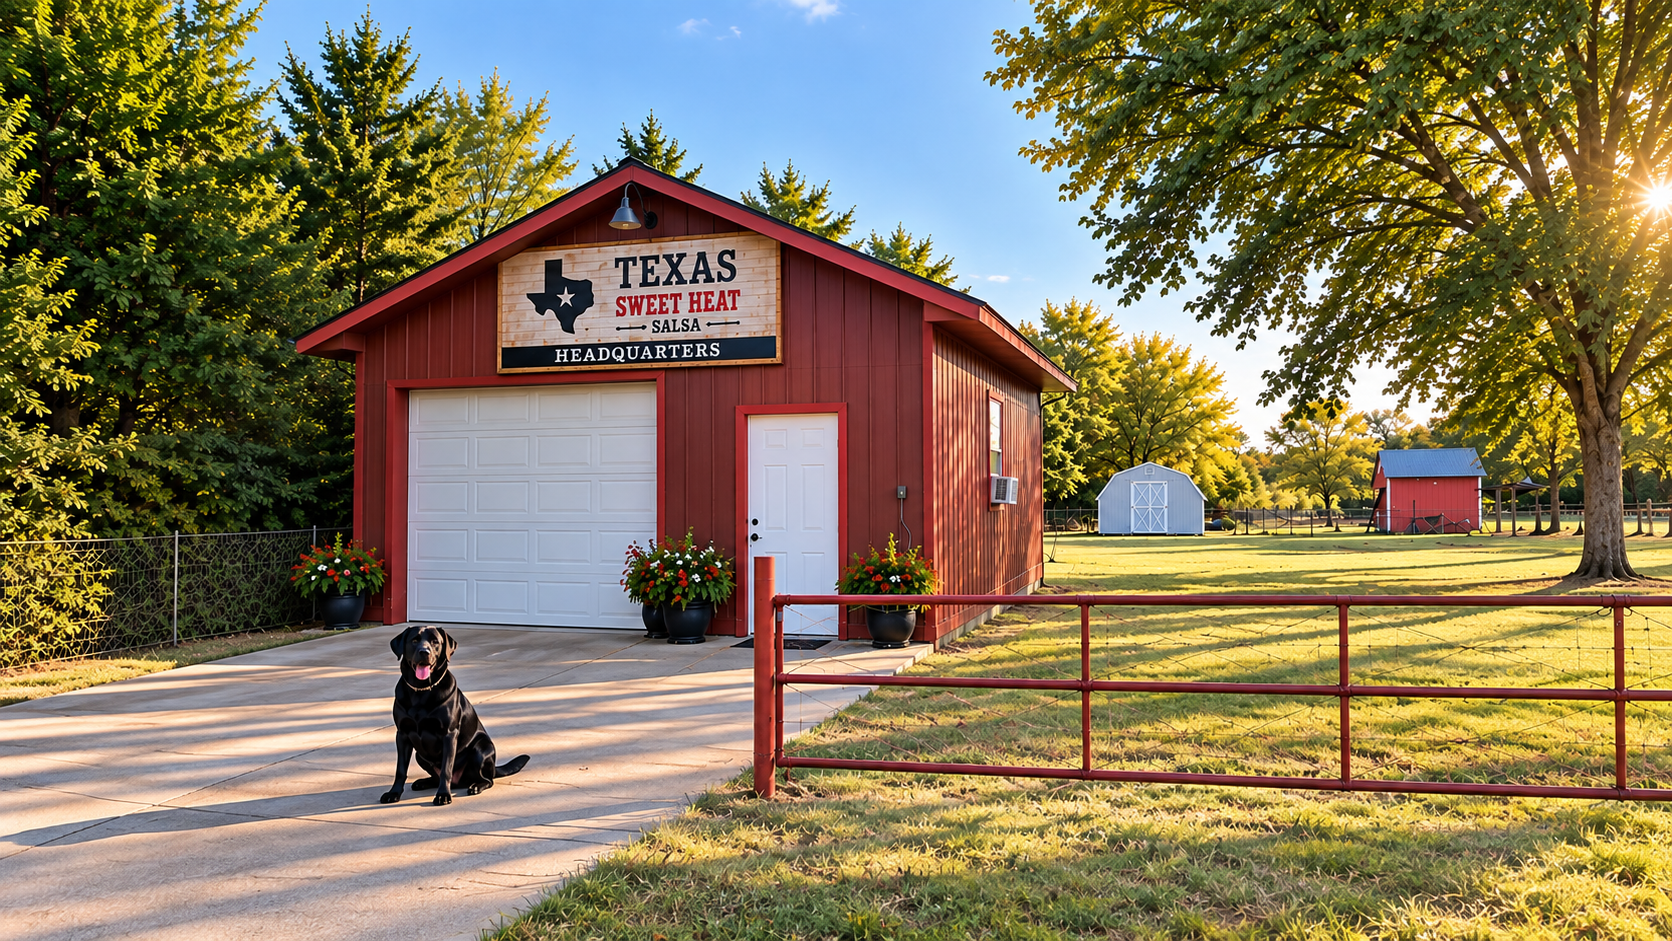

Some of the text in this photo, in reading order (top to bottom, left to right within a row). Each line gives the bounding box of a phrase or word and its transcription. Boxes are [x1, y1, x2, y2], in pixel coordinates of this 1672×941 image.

[614, 249, 737, 289] TEXAS
[615, 289, 741, 317] SWEET HEAT
[651, 318, 702, 334] SALSA
[554, 342, 721, 363] HEADQUARTERS
